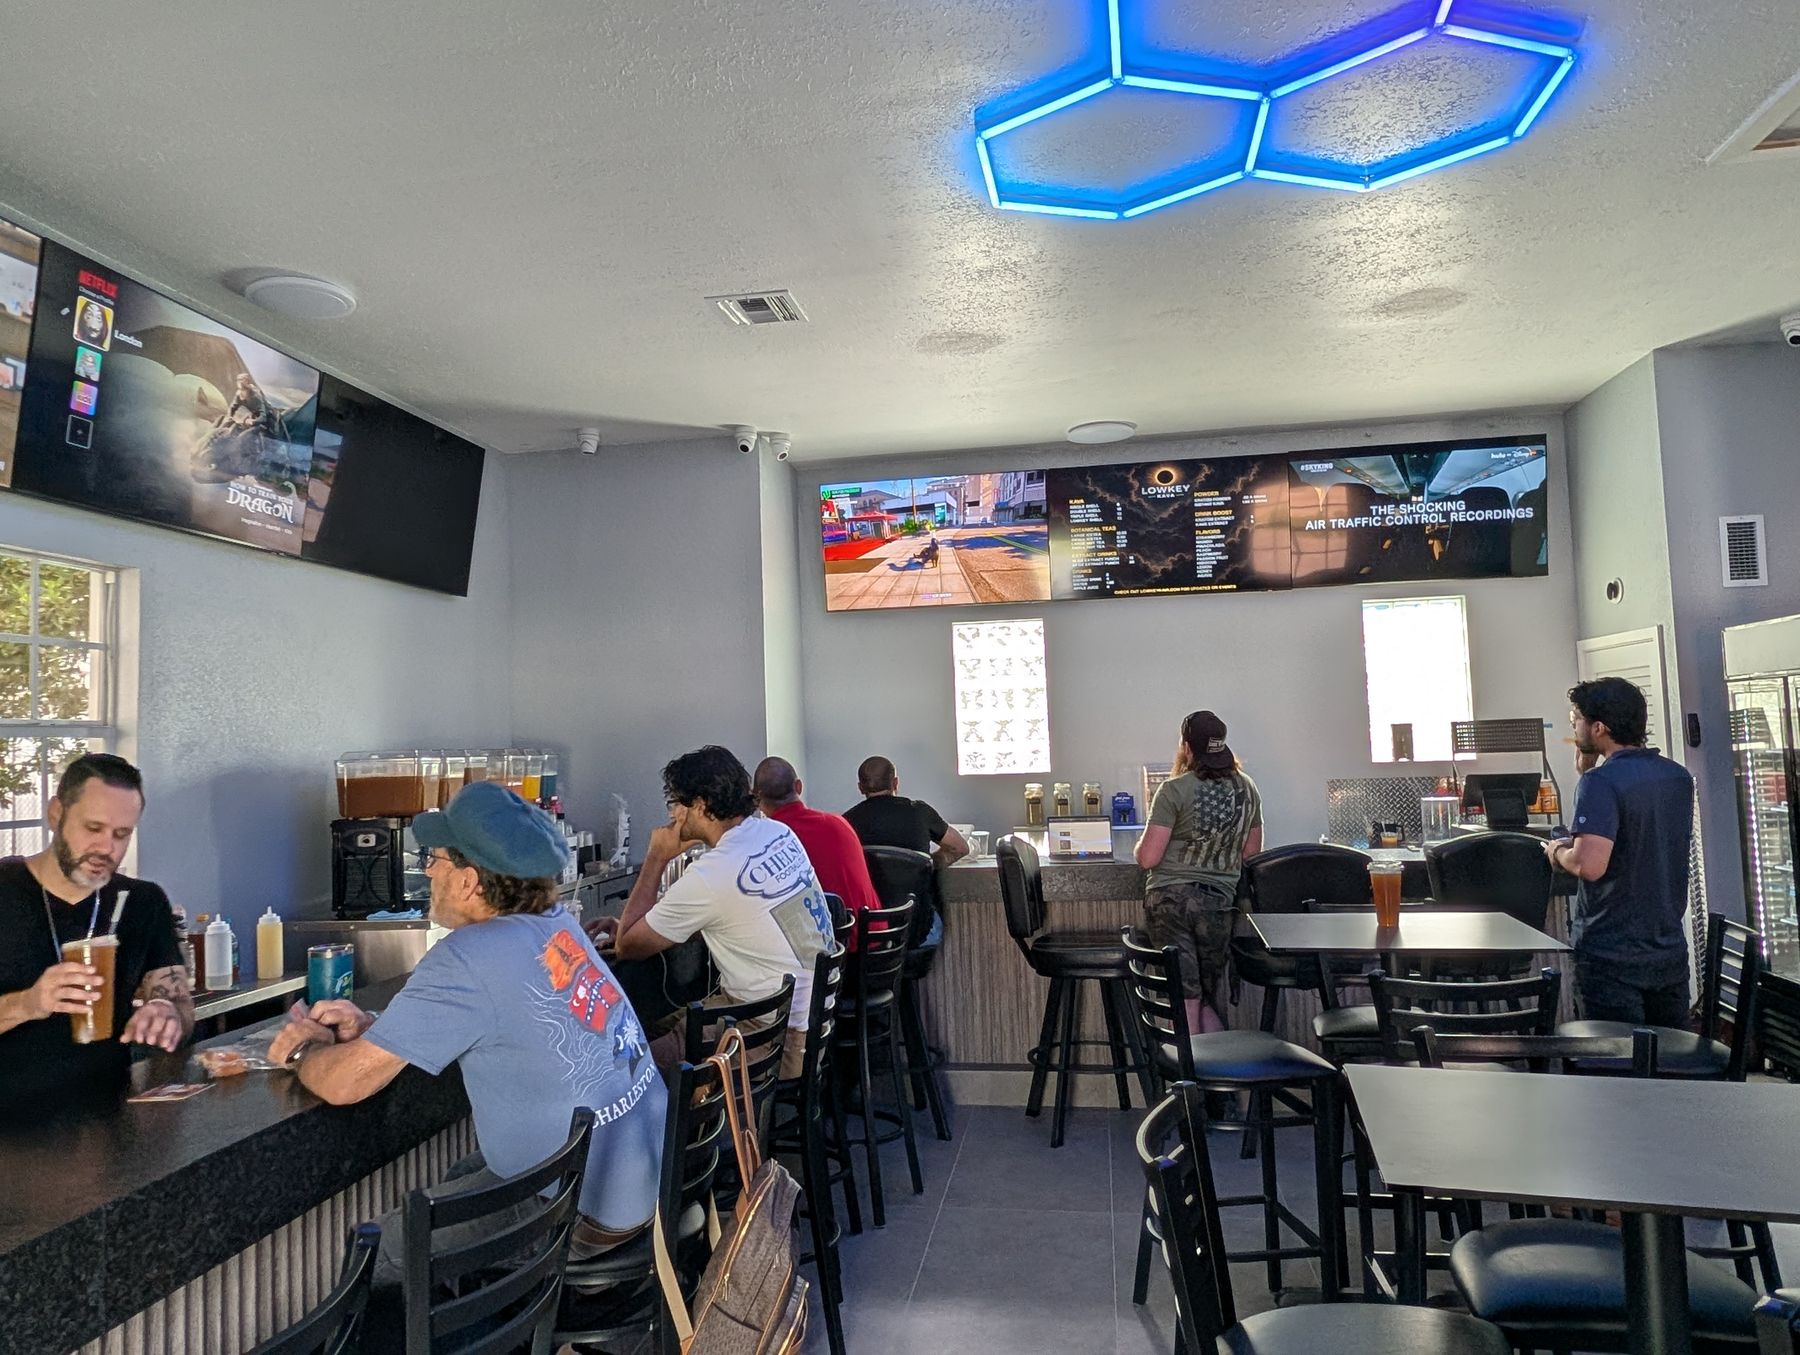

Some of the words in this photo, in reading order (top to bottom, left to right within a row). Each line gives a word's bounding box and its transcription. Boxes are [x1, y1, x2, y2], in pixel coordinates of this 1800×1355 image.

[79, 268, 119, 298] NETFLIX
[114, 329, 143, 348] London
[231, 481, 246, 490] HOW
[258, 490, 277, 500] TRAIN
[1141, 484, 1190, 495] LOWKEY
[225, 487, 294, 524] DRAGON
[1370, 505, 1395, 516] THE
[1399, 500, 1466, 515] SHOCKING
[1305, 519, 1326, 531] AIR
[1329, 516, 1382, 529] TRAFFIC
[1385, 512, 1447, 526] CONTROL
[1450, 506, 1535, 522] RECORDINGS
